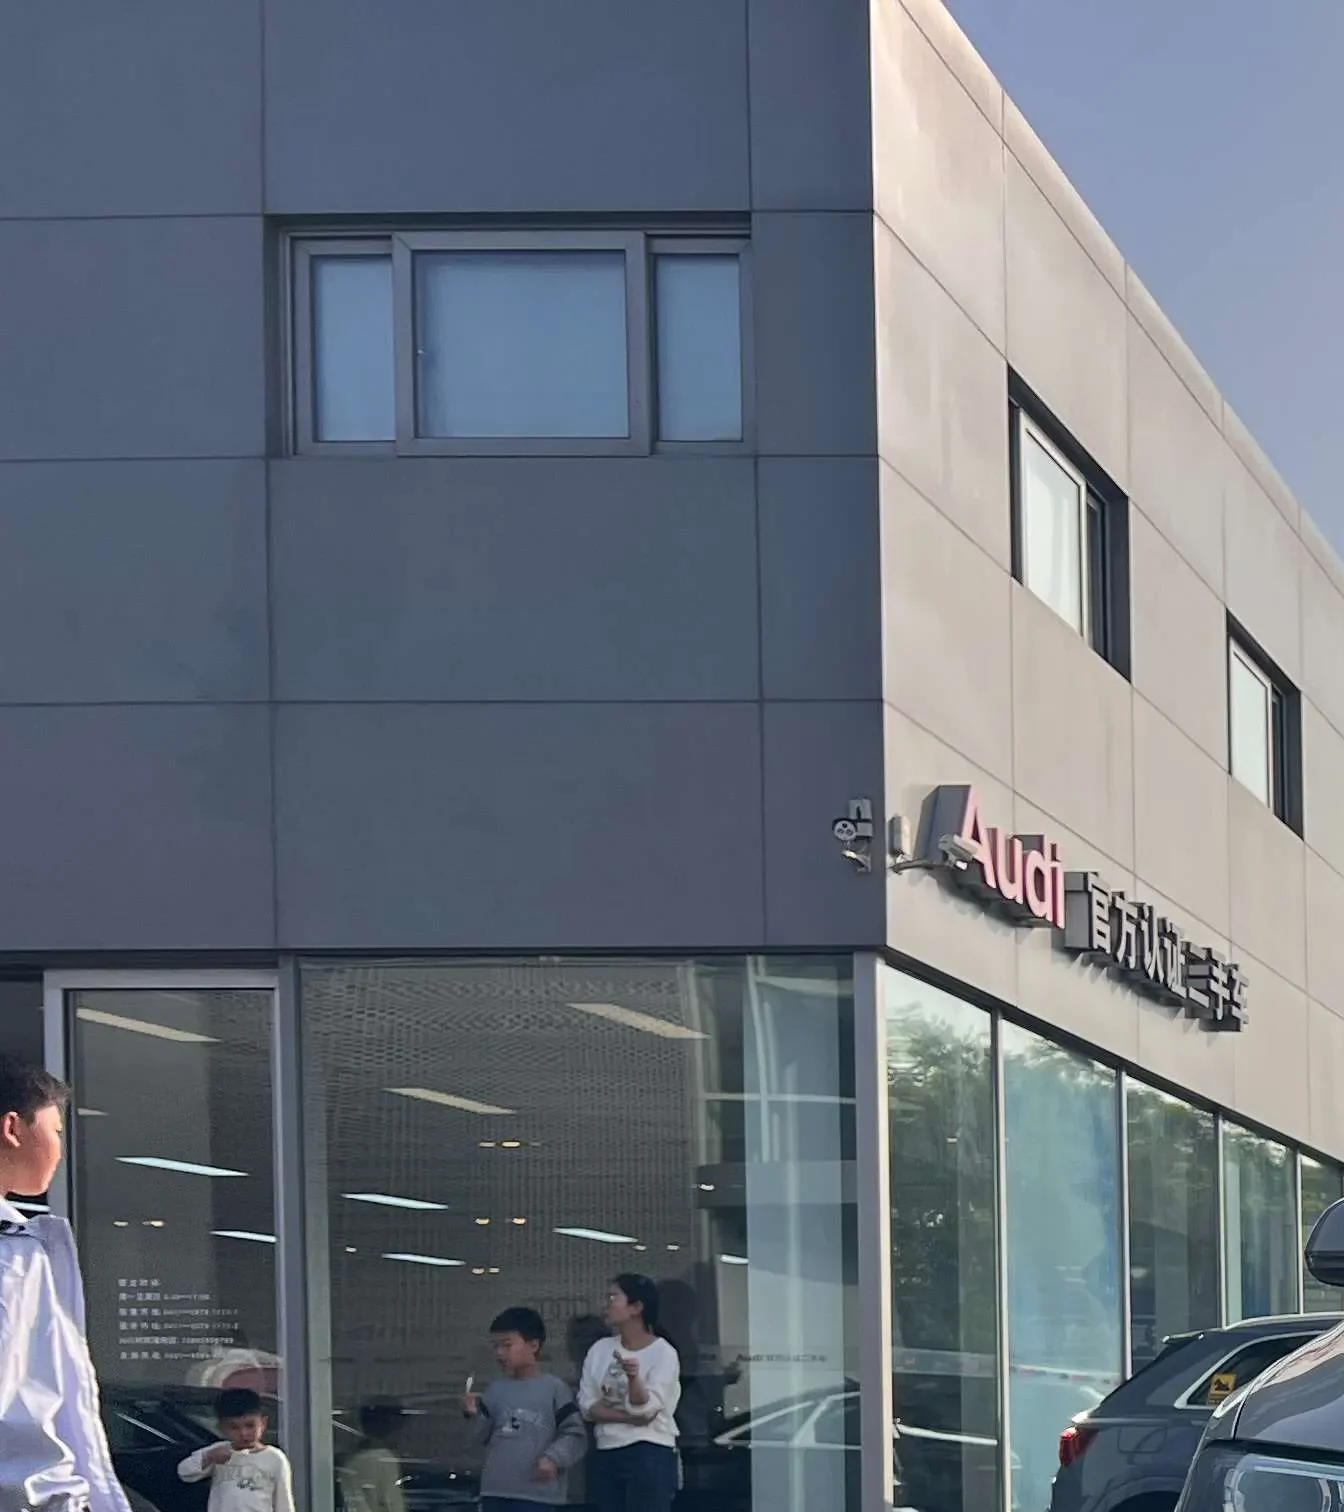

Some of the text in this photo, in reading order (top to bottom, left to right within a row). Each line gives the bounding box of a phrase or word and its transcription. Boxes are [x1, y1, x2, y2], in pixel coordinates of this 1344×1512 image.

[953, 784, 1250, 1026] Audi 官方认证二手车
